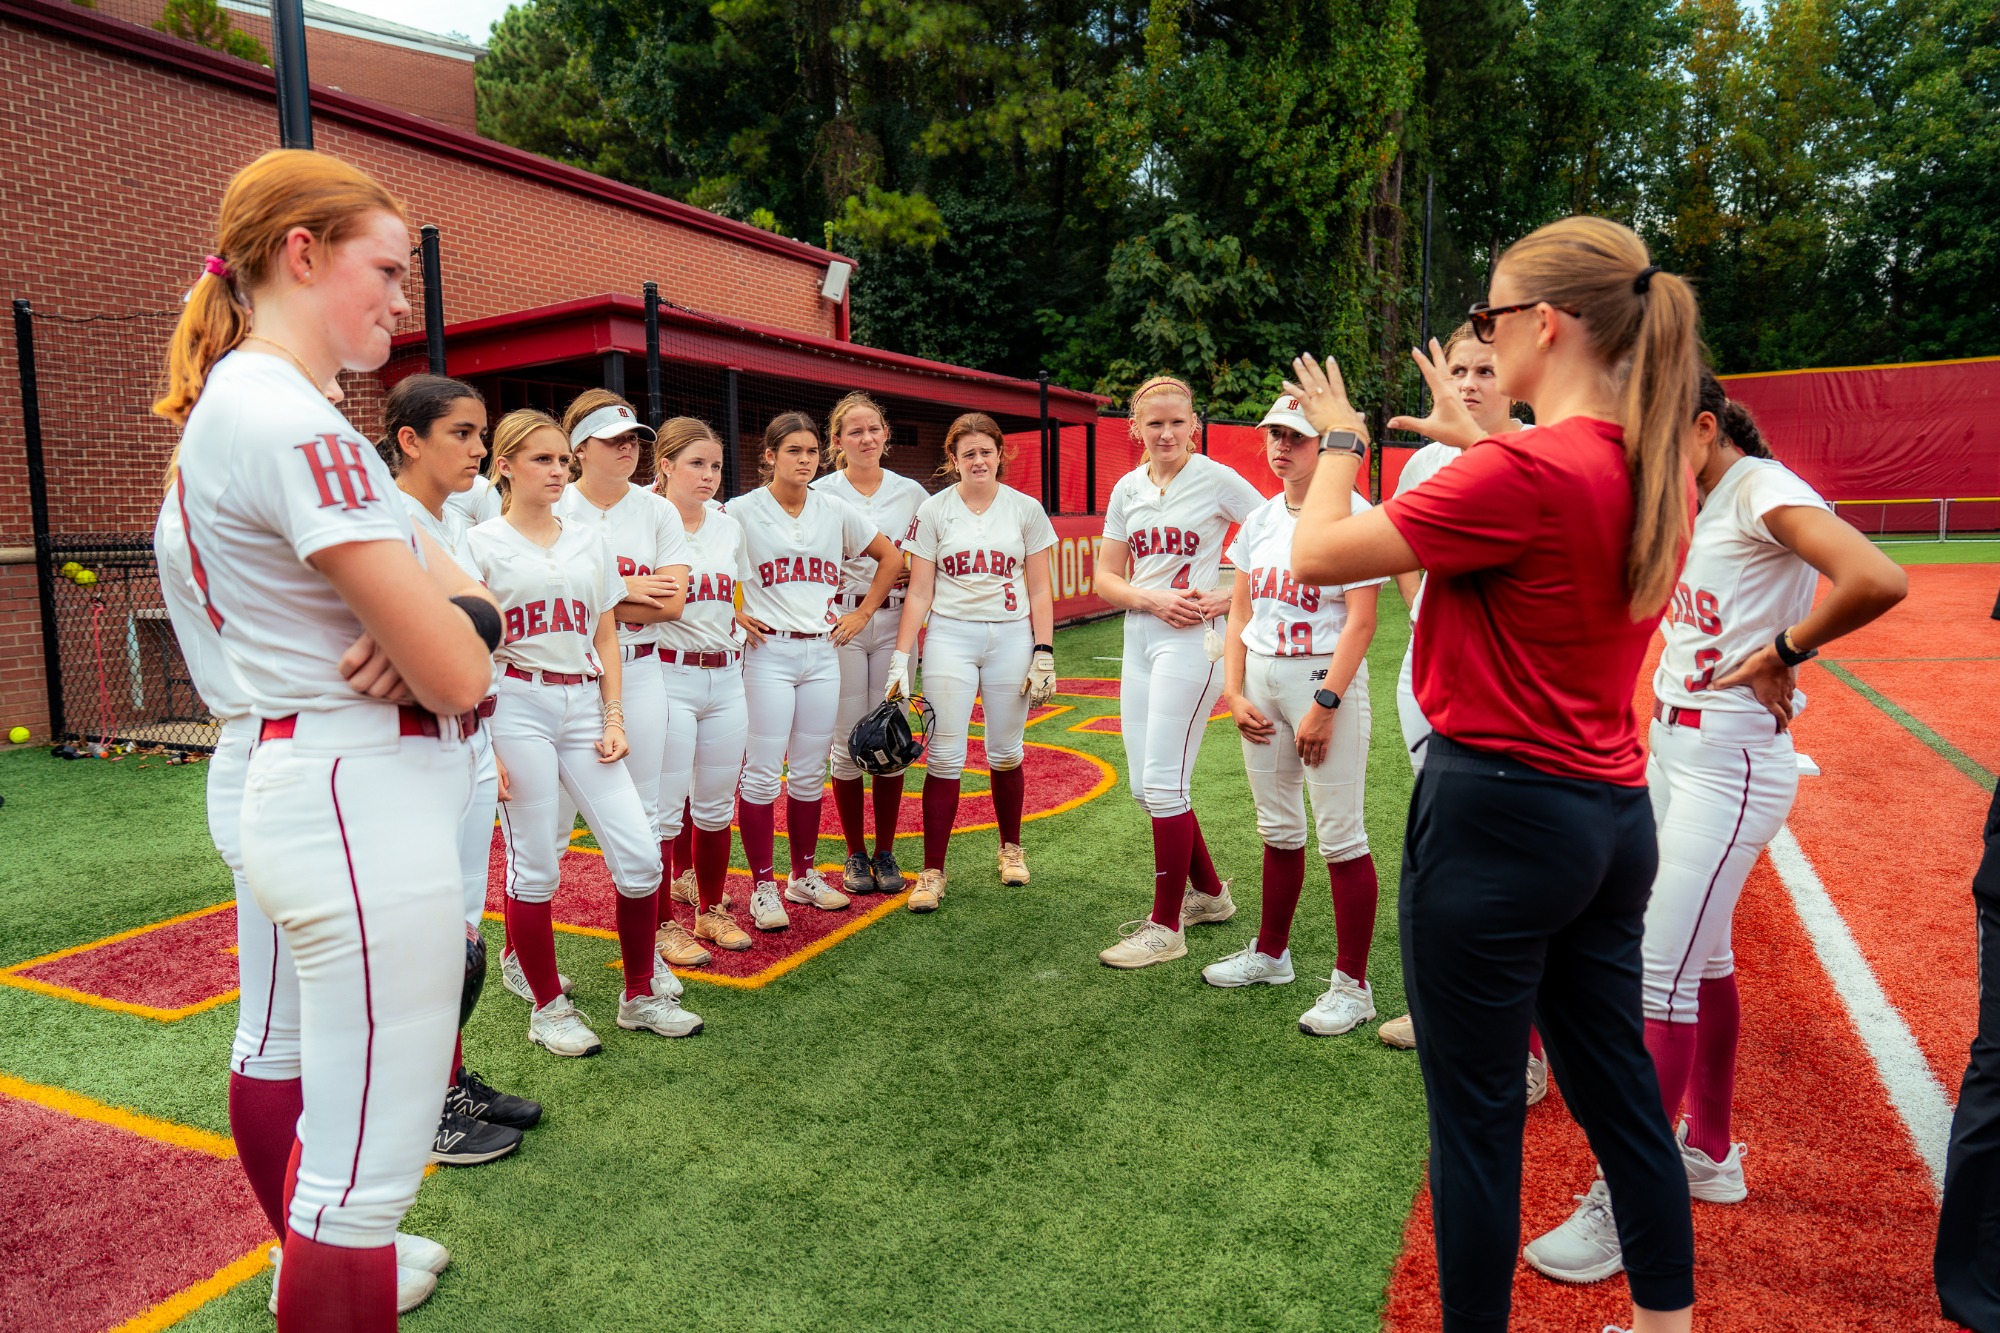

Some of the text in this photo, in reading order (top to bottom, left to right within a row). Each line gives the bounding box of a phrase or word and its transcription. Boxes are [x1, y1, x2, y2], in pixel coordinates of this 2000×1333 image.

[758, 556, 839, 589] BEARS
[943, 549, 1016, 578] BEARS
[1170, 563, 1191, 590] 4
[685, 572, 737, 605] EAR
[1002, 582, 1017, 612] 5
[1248, 566, 1321, 613] EARS
[503, 597, 591, 647] BEAR
[1275, 621, 1313, 656] 19
